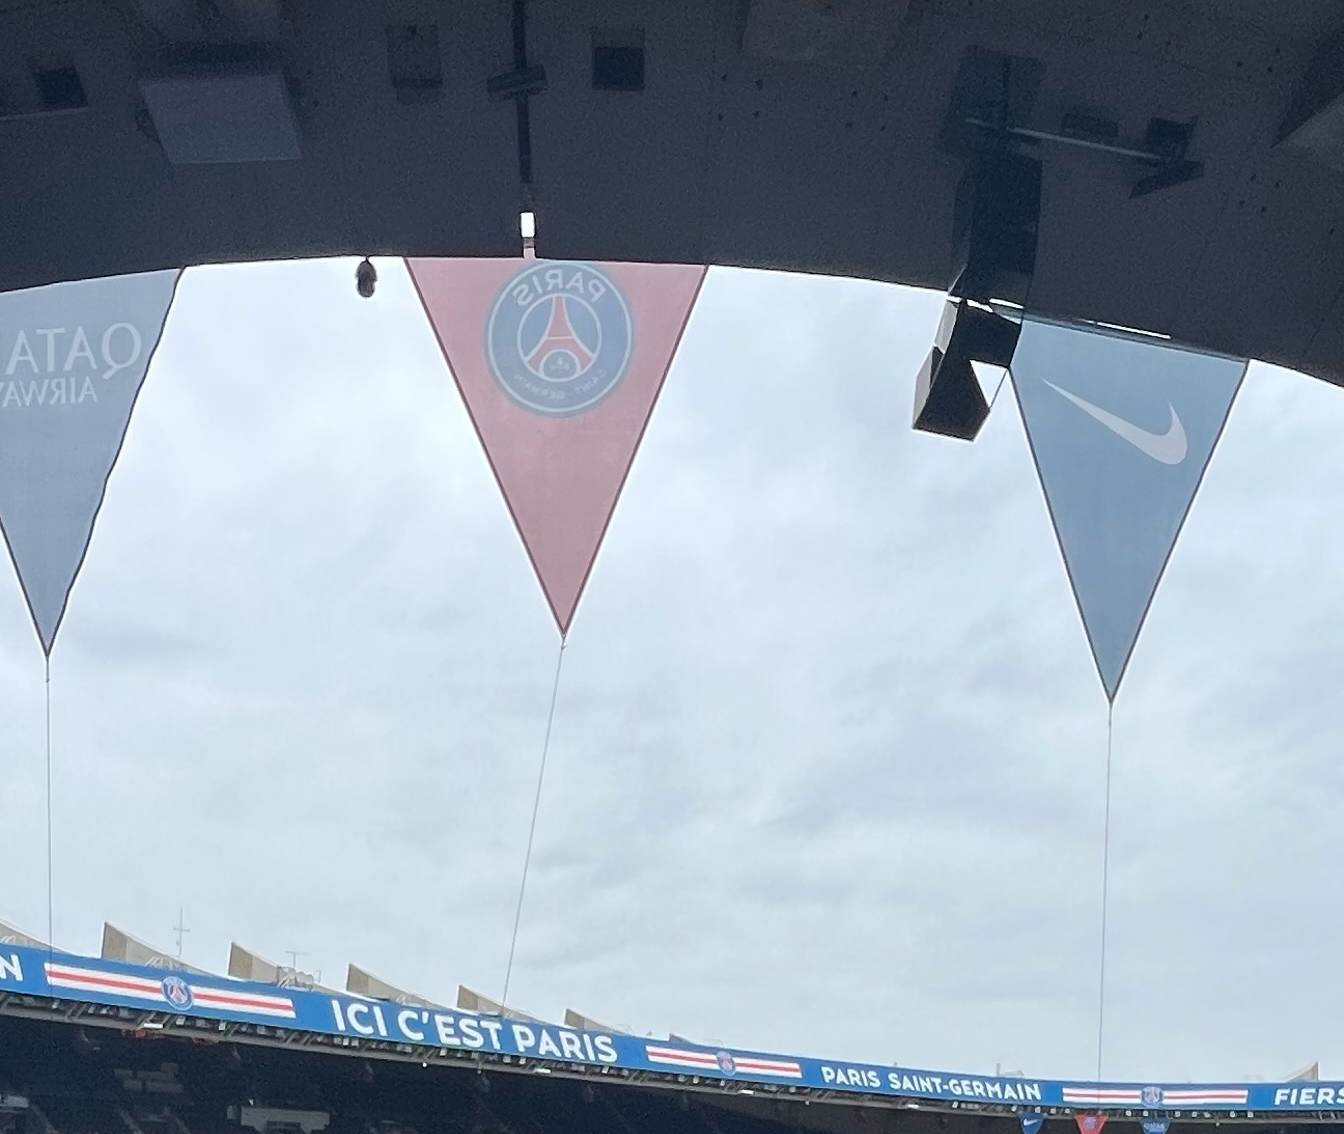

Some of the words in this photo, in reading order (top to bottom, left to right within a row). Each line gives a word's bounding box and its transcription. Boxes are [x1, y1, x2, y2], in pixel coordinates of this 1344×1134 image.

[331, 1000, 388, 1037] ICI
[398, 1010, 502, 1050] C'EST
[512, 1024, 618, 1063] PARIS
[821, 1066, 881, 1087] PARIS
[888, 1072, 1042, 1100] SAINT-GERMAIN
